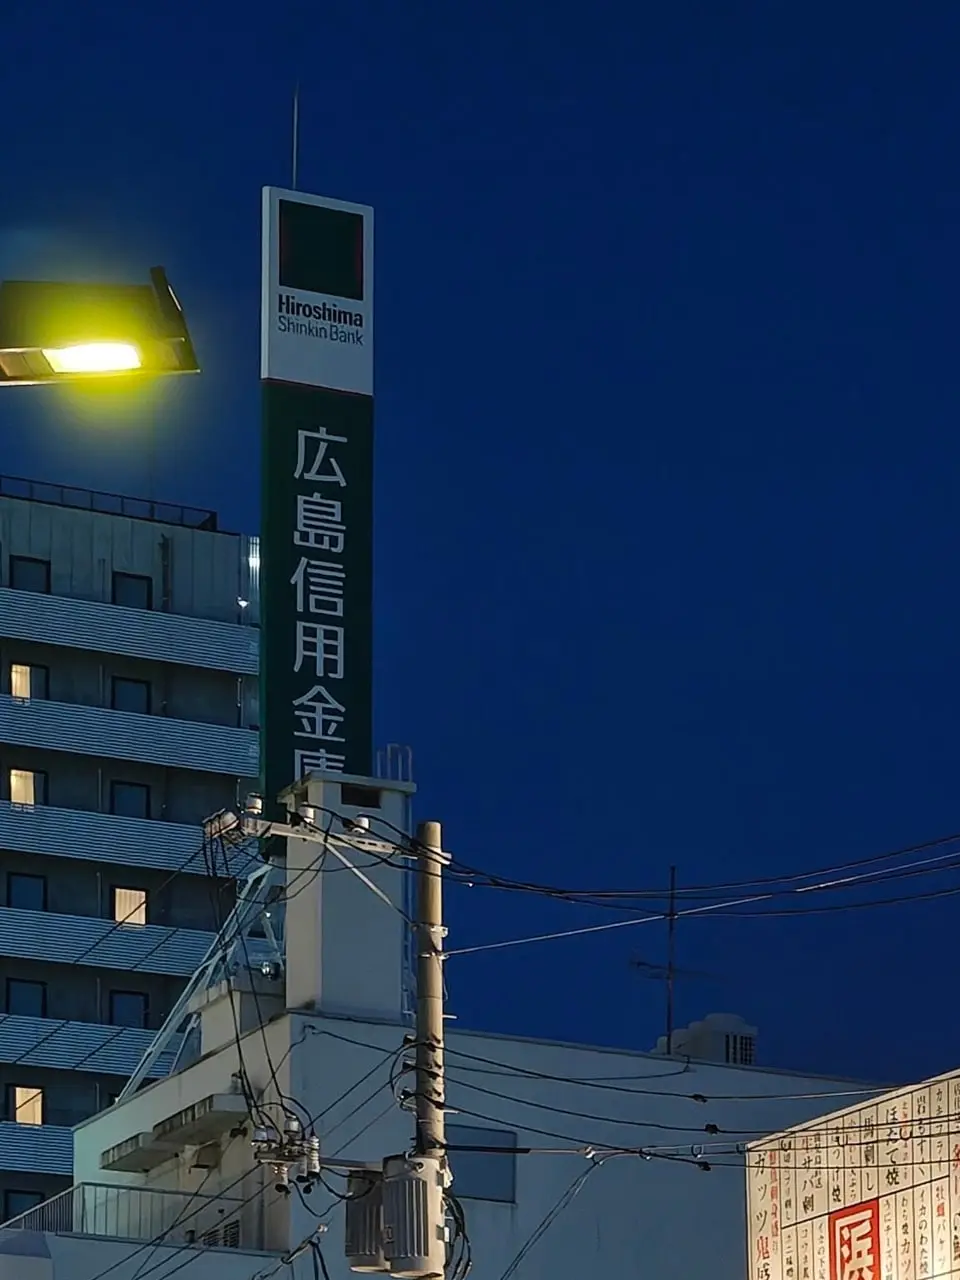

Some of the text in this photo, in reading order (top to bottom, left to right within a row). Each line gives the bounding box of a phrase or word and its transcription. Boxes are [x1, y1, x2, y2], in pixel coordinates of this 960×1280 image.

[278, 294, 363, 327] Hiroshima
[278, 315, 363, 346] Shinkin Bank
